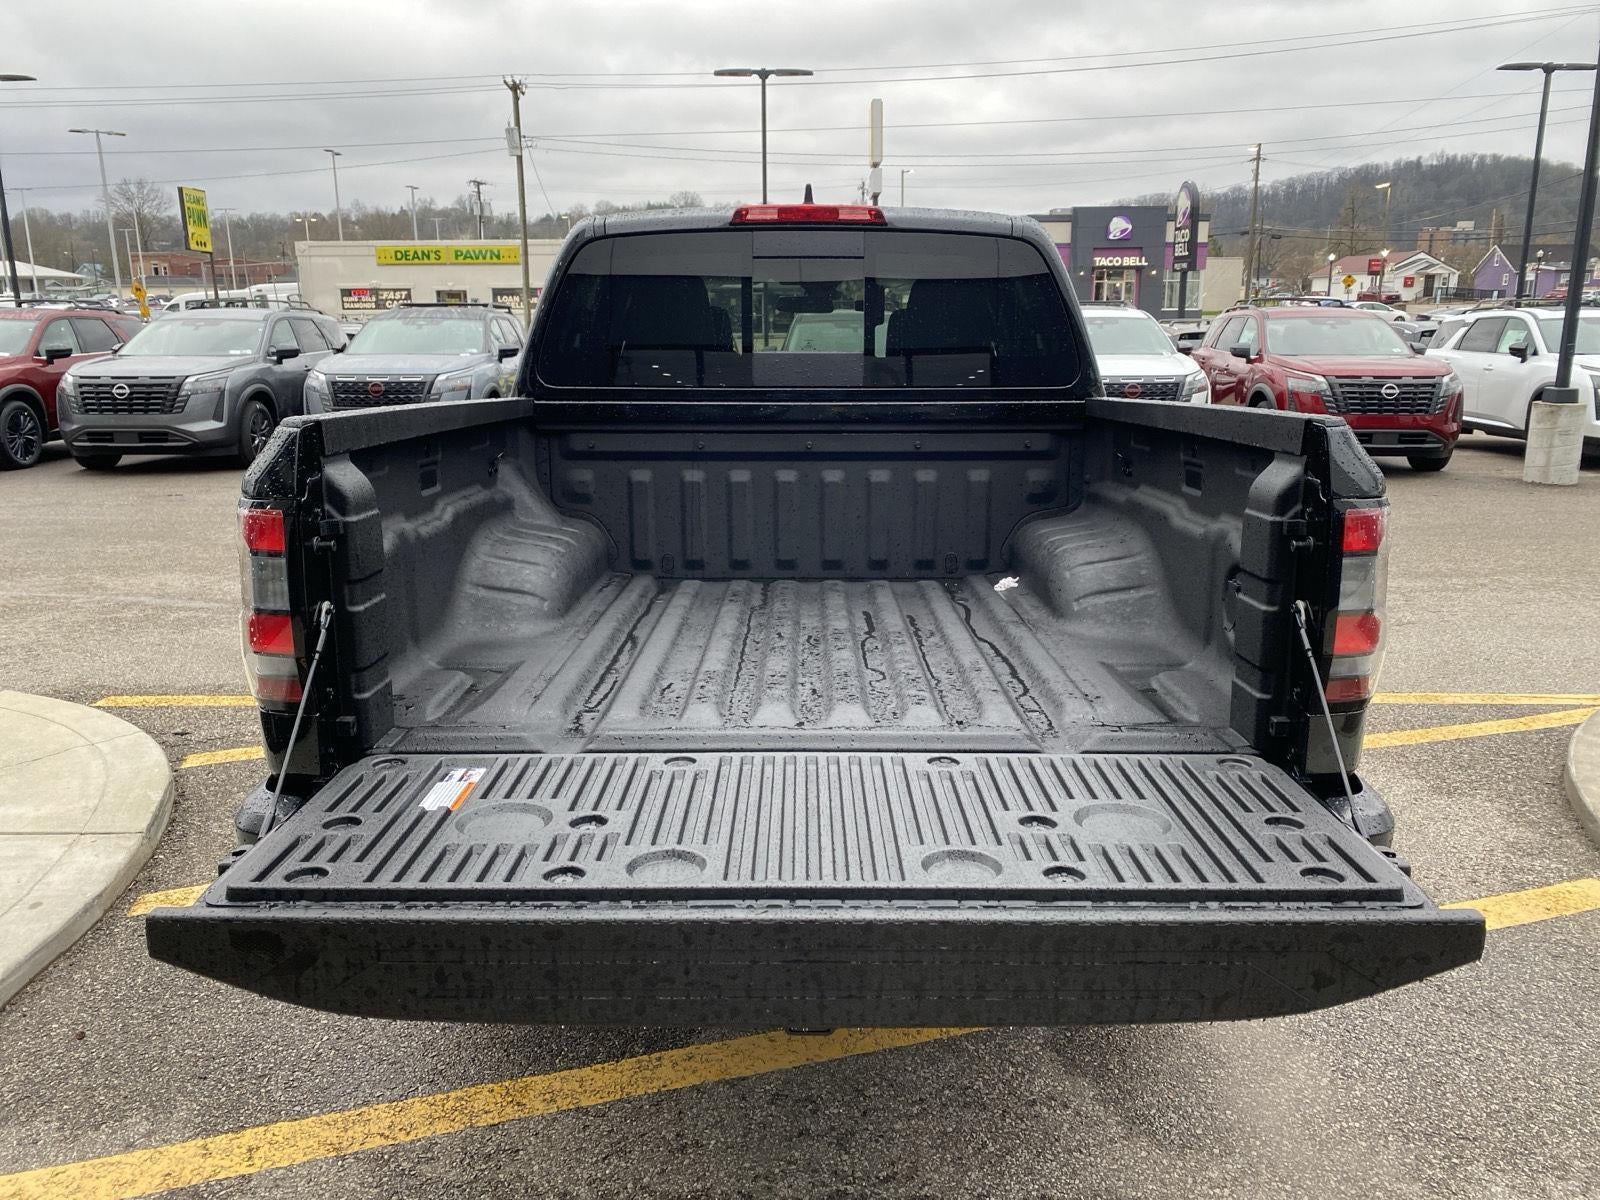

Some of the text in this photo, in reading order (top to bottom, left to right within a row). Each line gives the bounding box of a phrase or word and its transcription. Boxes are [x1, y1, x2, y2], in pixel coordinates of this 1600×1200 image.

[187, 207, 208, 229] PAWN
[1175, 228, 1190, 244] TACO
[394, 249, 501, 261] DEAN'S PAWN
[1174, 242, 1189, 256] BELL
[1093, 256, 1149, 266] TACO BELL
[383, 290, 408, 300] FAST
